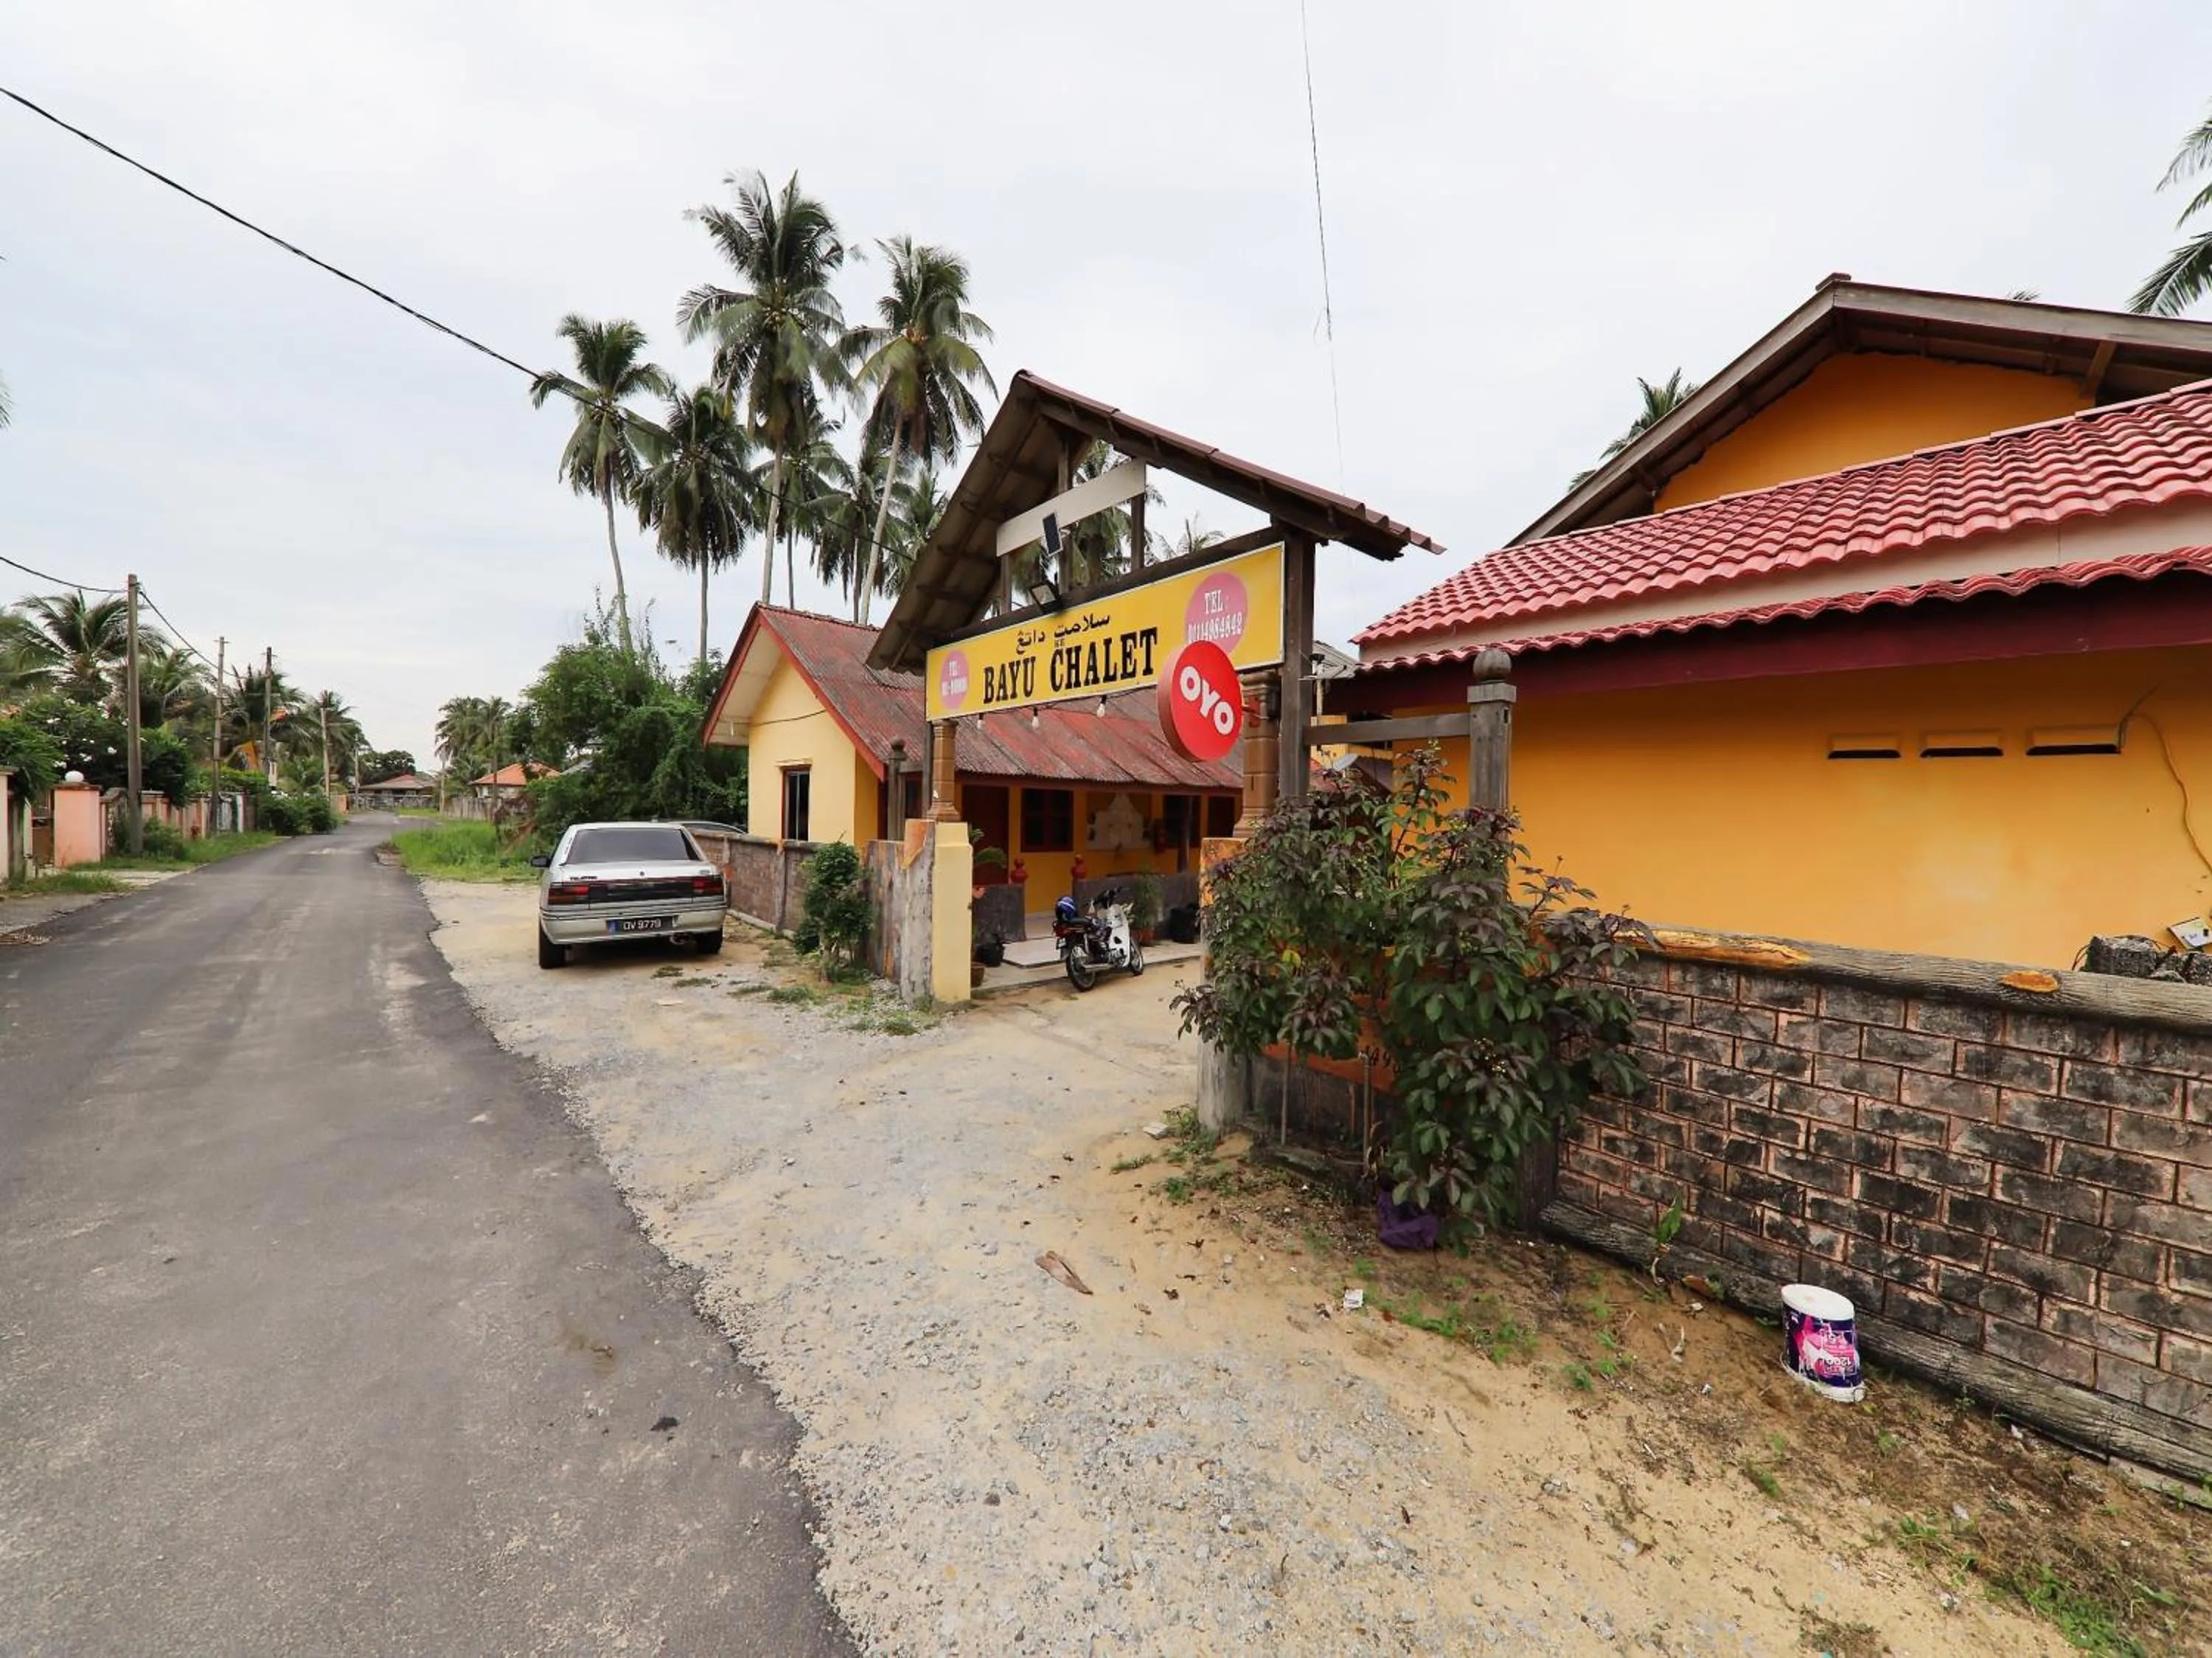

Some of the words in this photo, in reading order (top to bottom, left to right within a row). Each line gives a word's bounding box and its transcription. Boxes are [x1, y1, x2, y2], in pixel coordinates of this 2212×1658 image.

[983, 656, 1036, 704] BAYU
[1050, 627, 1158, 693] CHALET
[1180, 665, 1234, 735] OYO
